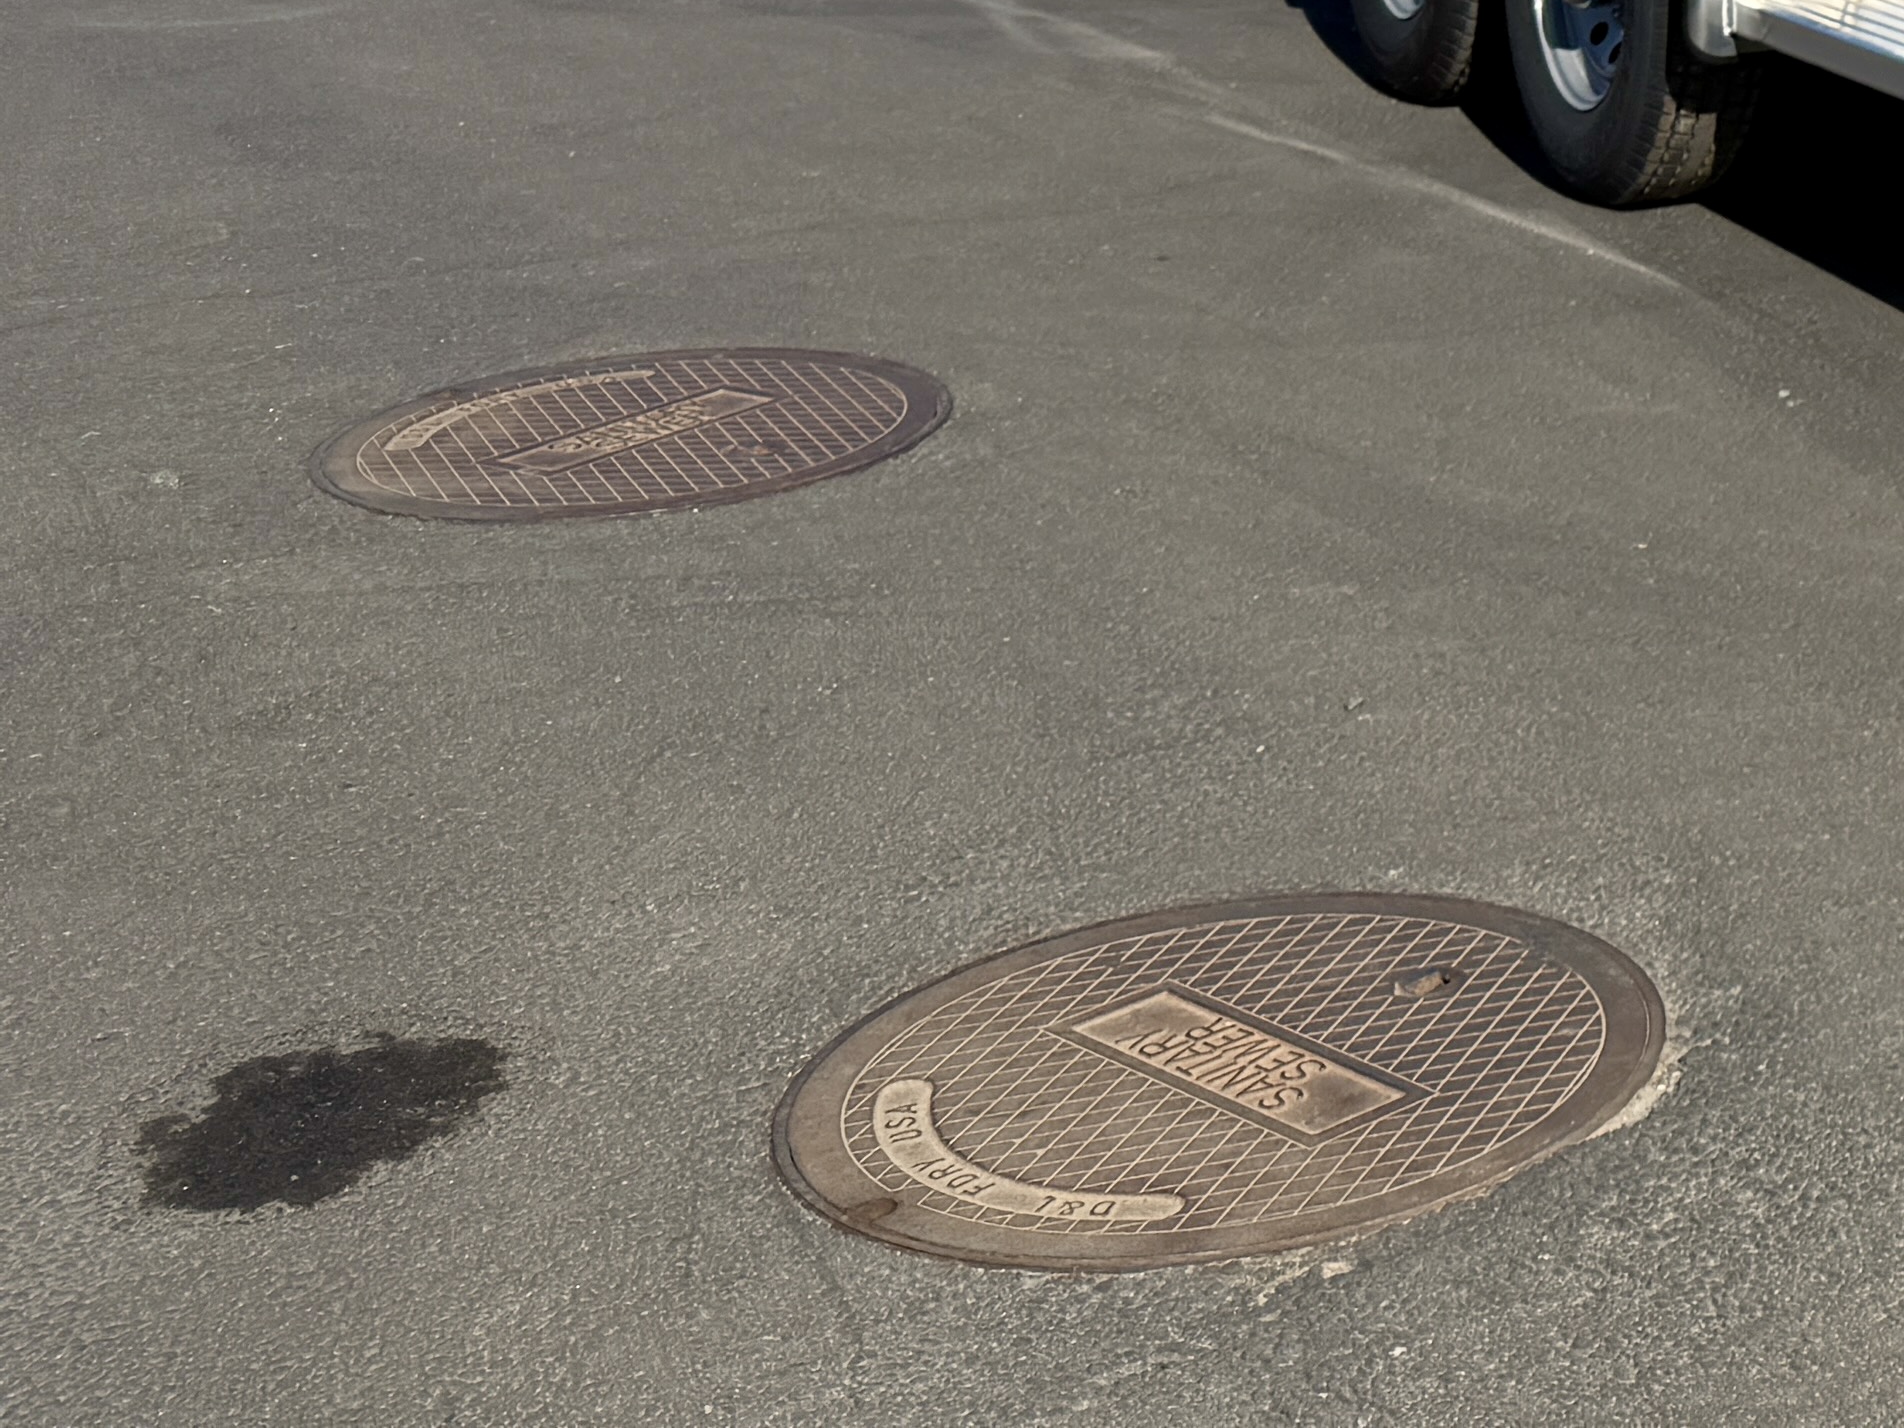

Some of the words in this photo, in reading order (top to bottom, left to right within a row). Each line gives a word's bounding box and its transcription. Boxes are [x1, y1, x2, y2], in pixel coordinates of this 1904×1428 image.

[1115, 1028, 1305, 1110] SANITARY
[1186, 1017, 1327, 1081] SEWER
[884, 1102, 923, 1144] USA
[911, 1157, 996, 1196] FDRY
